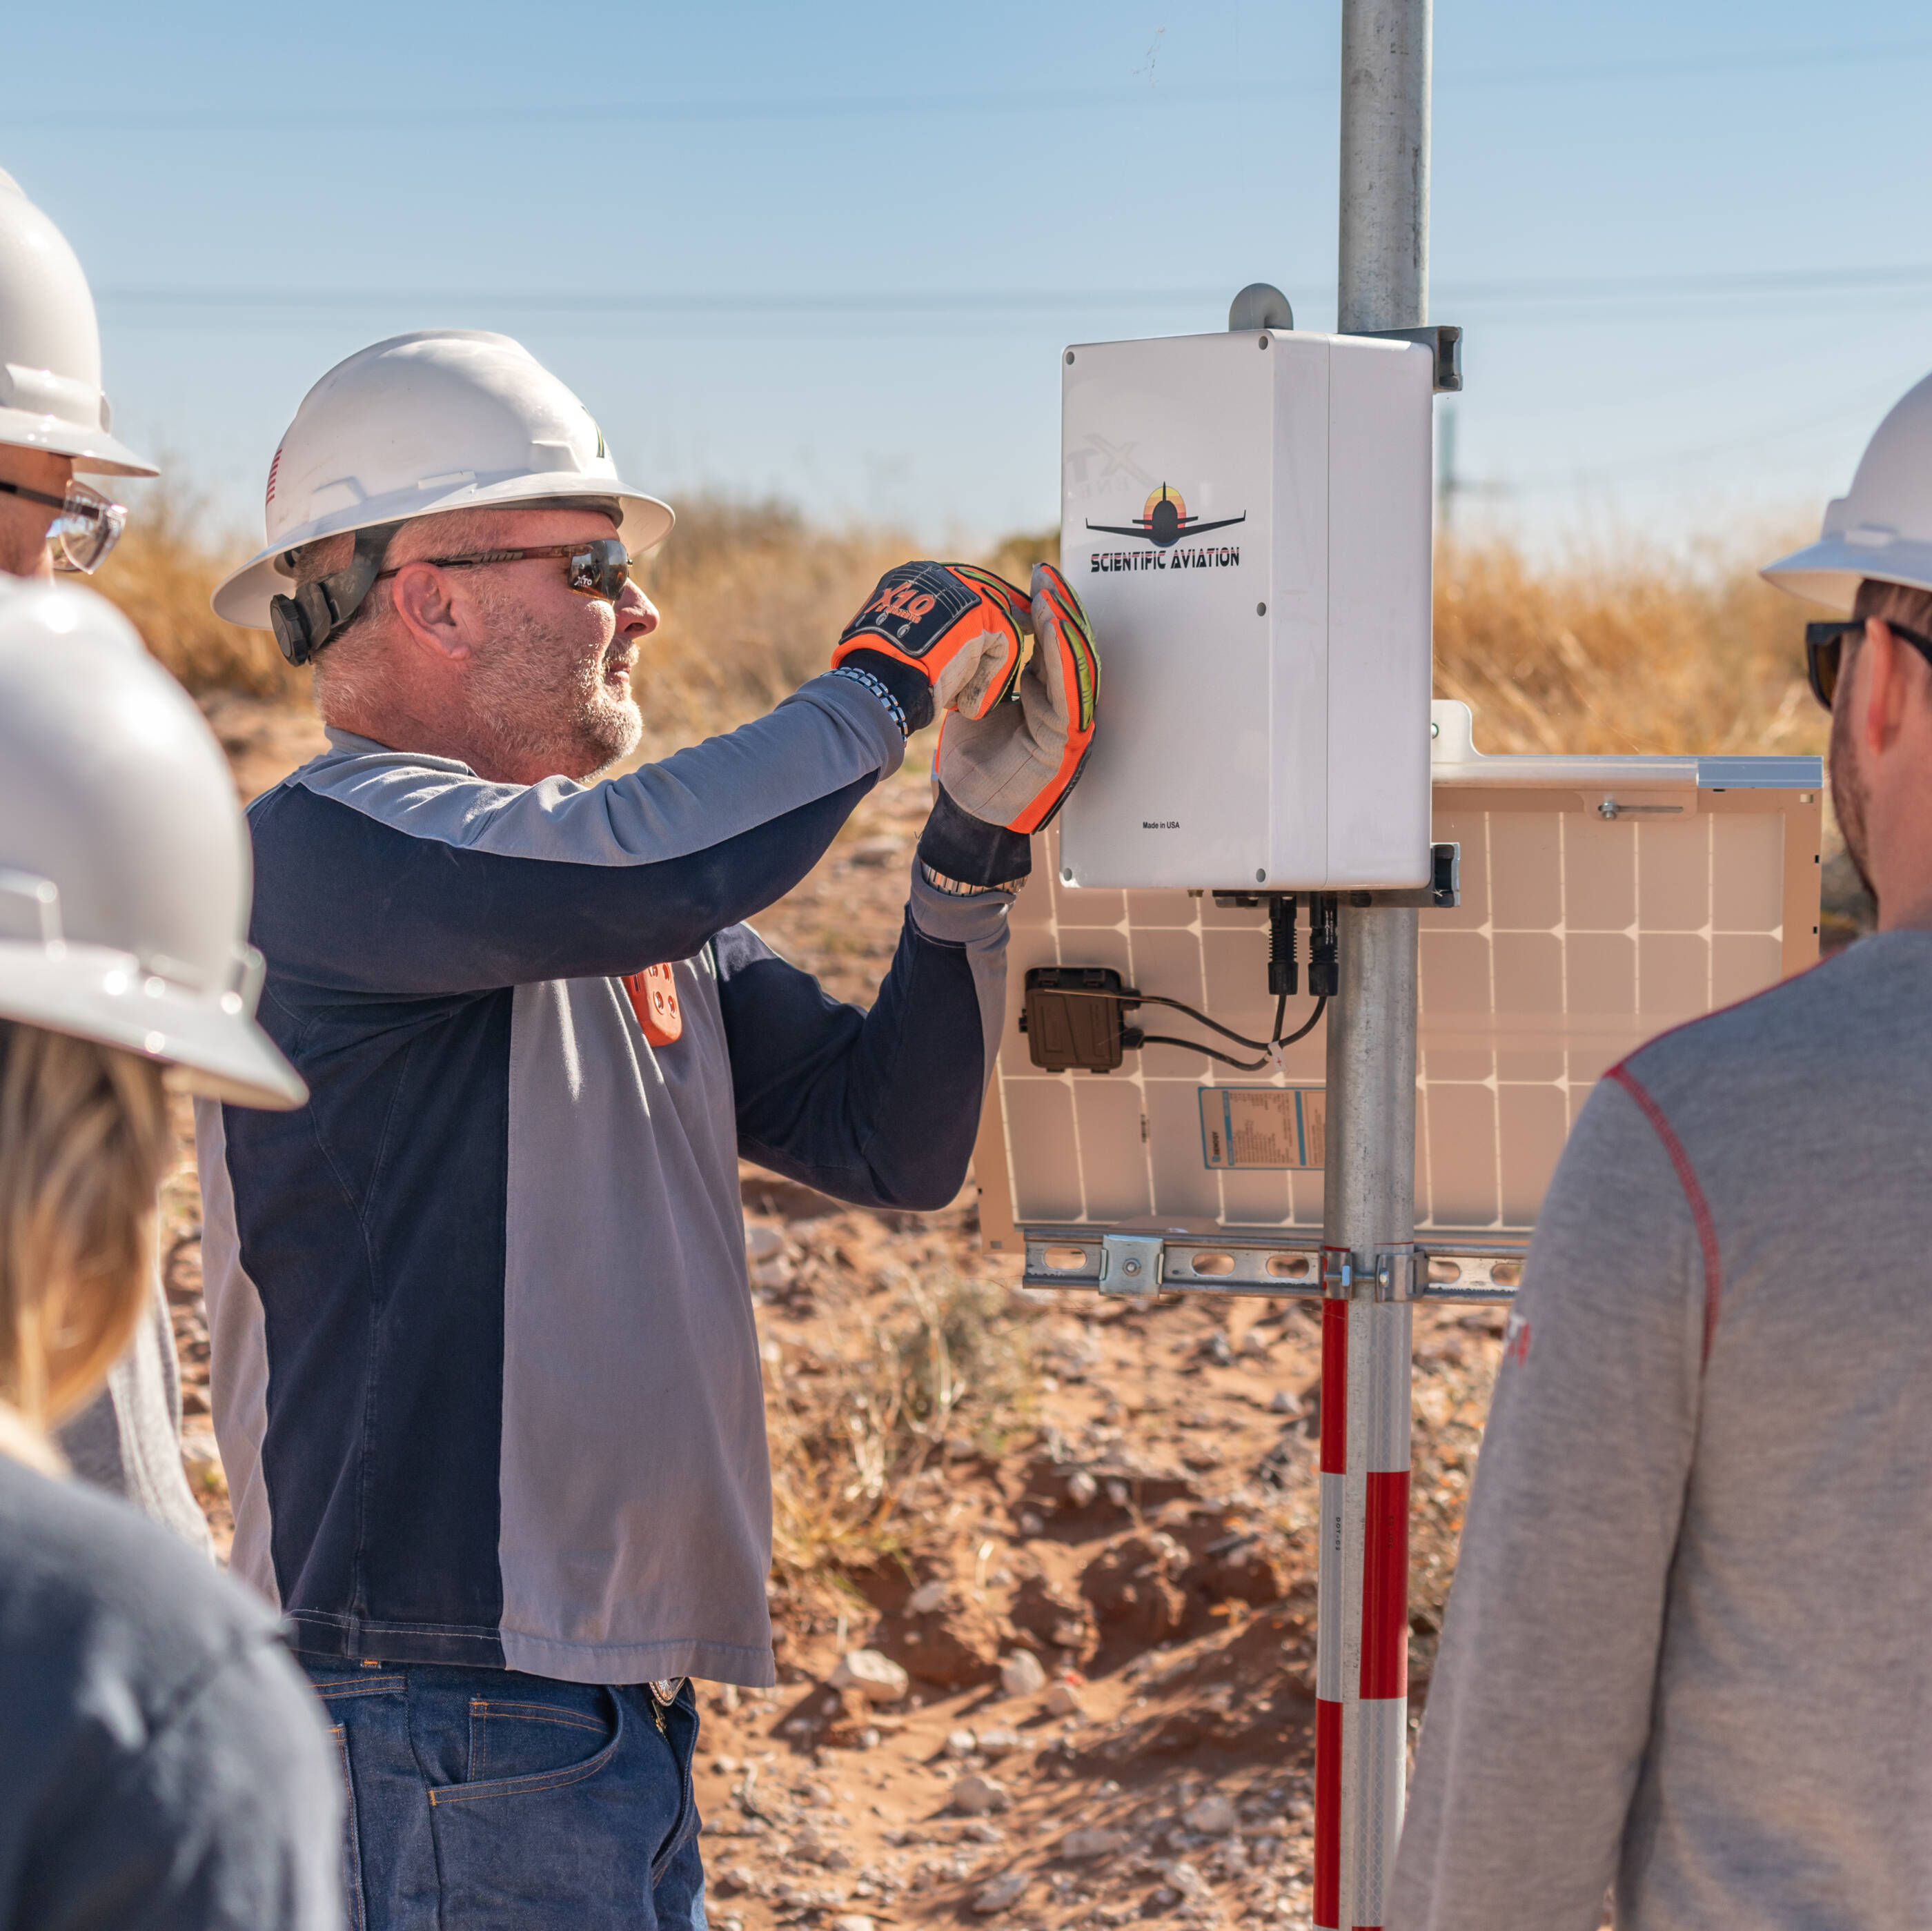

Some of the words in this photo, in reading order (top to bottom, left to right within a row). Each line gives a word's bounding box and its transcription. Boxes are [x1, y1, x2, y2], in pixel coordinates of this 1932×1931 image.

[1091, 551, 1166, 573] SCIENTIFIC
[1170, 546, 1240, 569] AVIATION
[573, 575, 593, 586] XTO
[863, 582, 936, 616] X10
